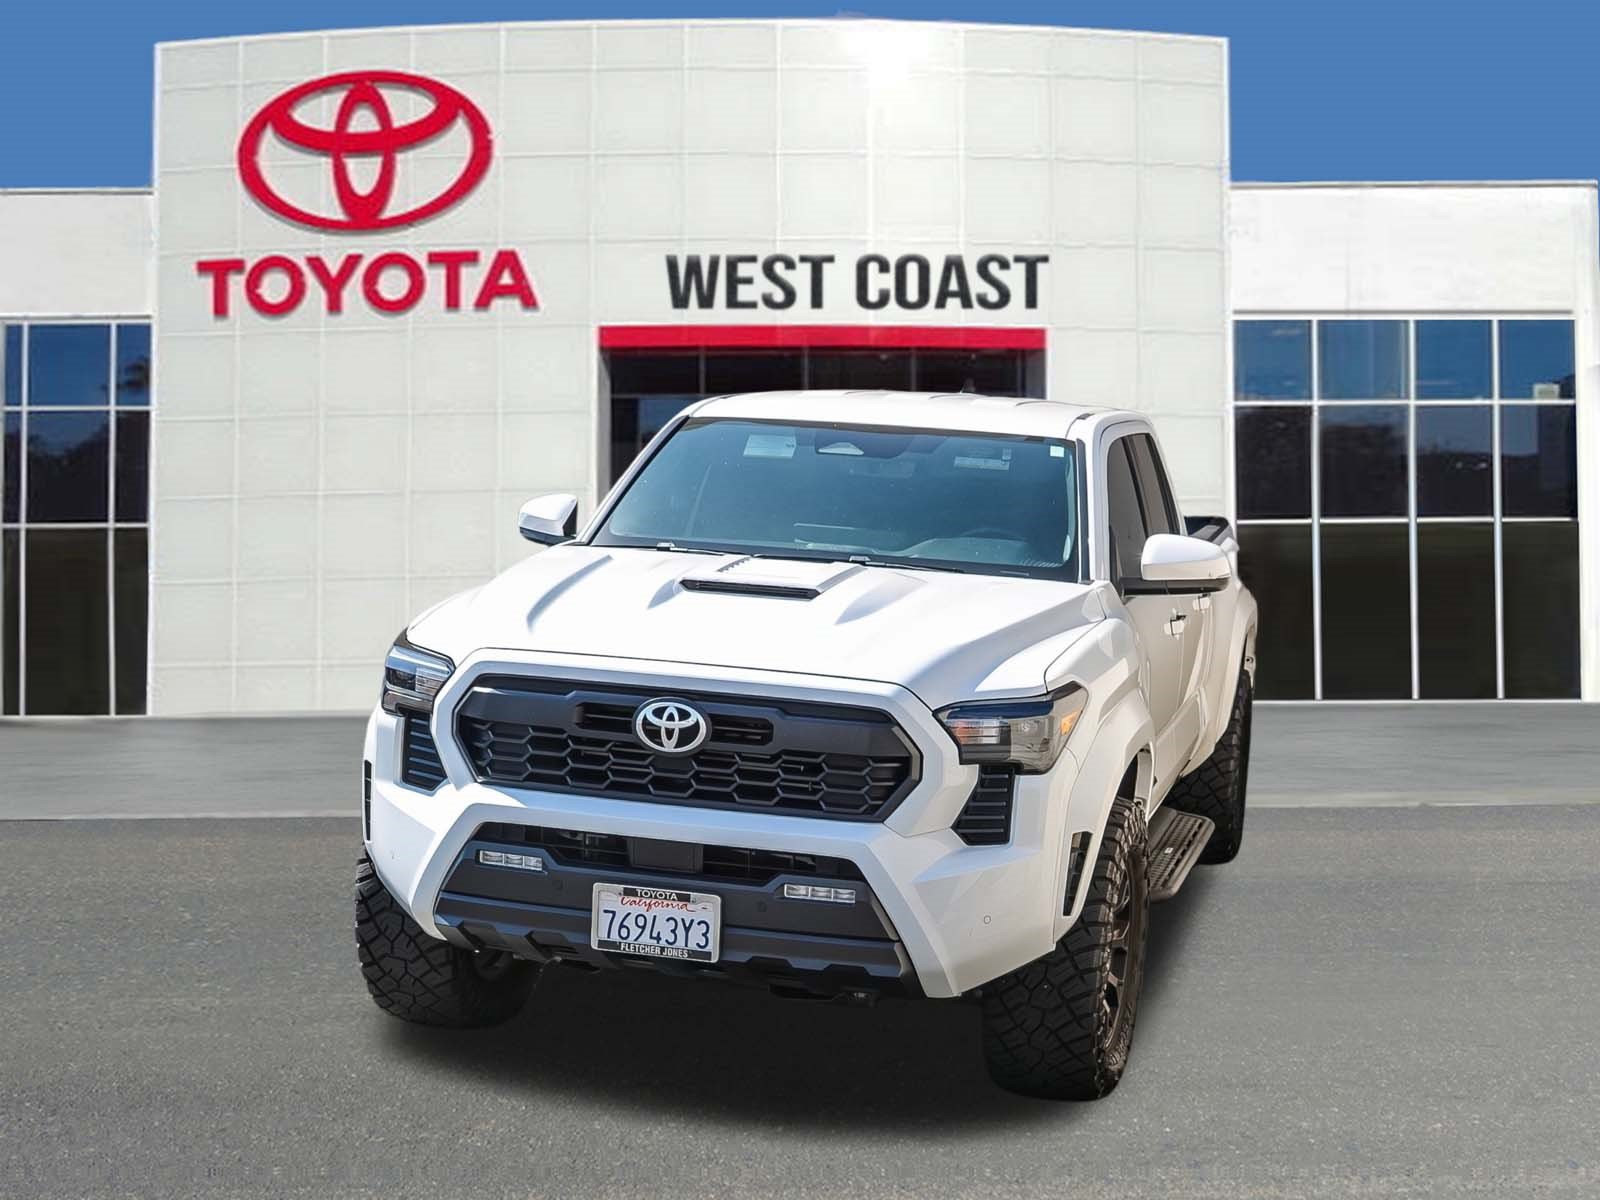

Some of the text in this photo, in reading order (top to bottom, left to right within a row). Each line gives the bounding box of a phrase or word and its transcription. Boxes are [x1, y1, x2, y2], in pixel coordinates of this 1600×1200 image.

[196, 250, 539, 318] TOYOTA
[665, 254, 1049, 310] WEST COAST
[620, 896, 696, 912] California
[636, 888, 678, 900] TOYOTA
[603, 909, 710, 949] 76943Y3
[620, 942, 688, 958] FLETCHER JONES
